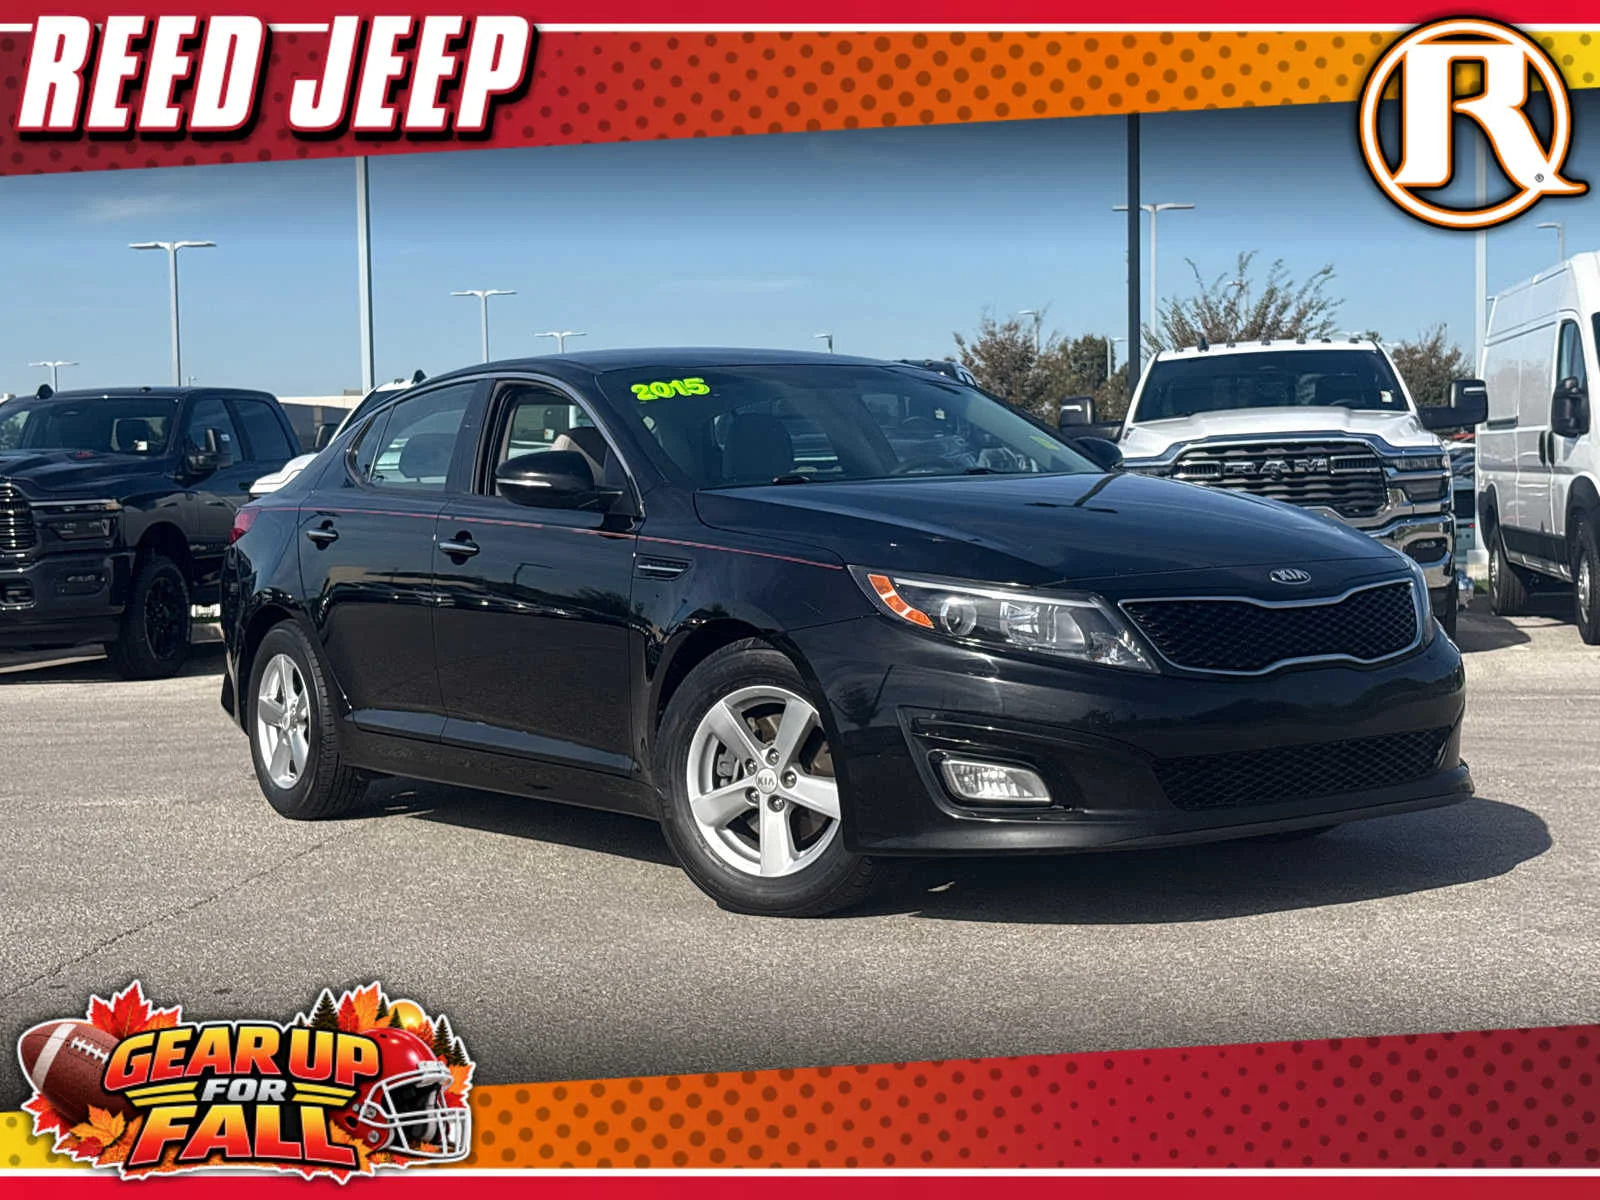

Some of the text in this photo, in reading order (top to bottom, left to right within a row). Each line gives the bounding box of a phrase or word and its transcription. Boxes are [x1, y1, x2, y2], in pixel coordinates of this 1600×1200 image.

[630, 377, 710, 400] 2015
[1223, 458, 1328, 477] RAM
[1273, 568, 1309, 582] KIA
[757, 776, 775, 786] KIA
